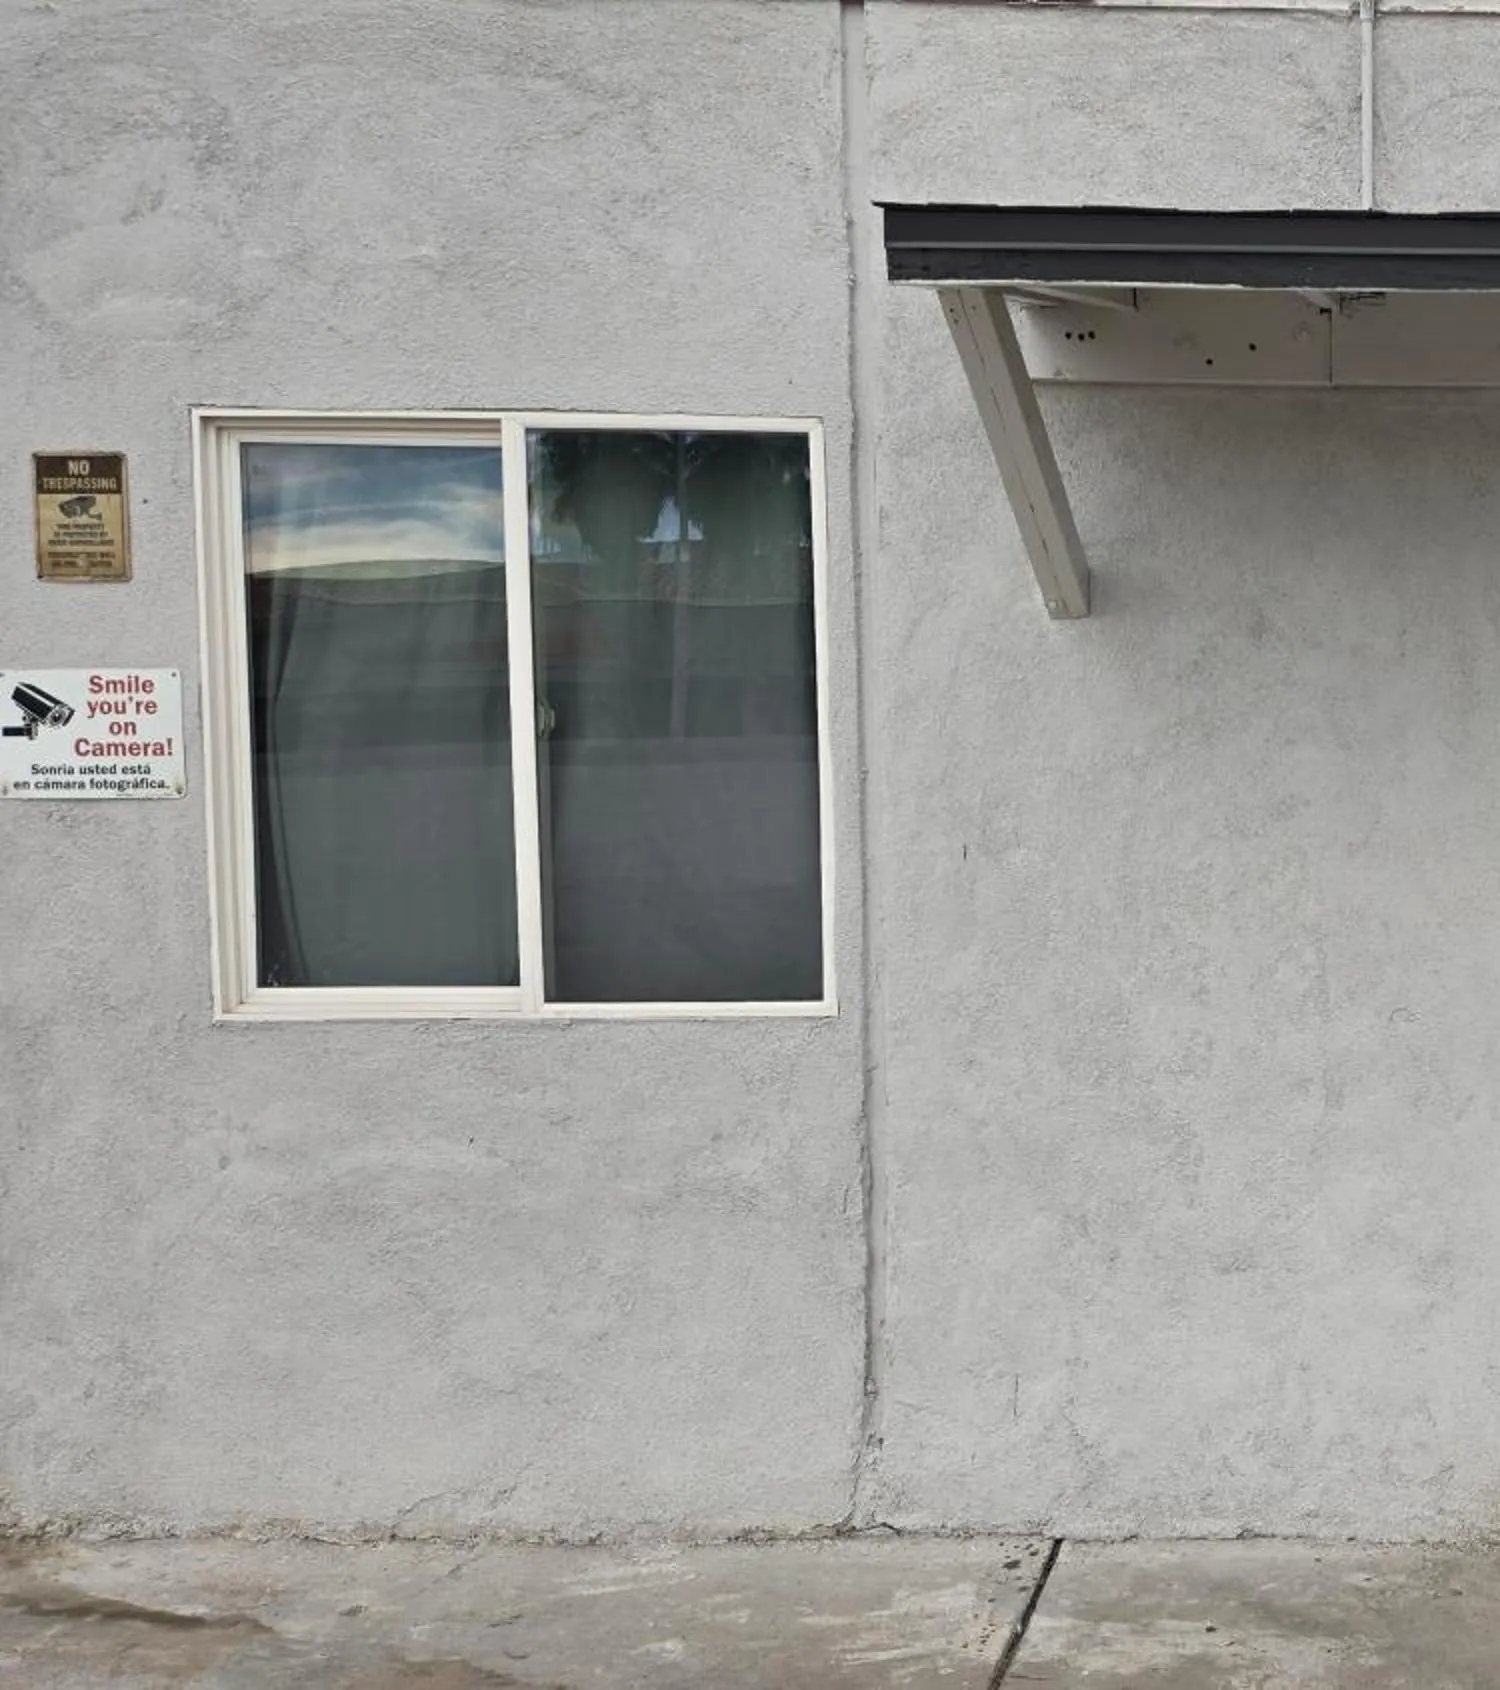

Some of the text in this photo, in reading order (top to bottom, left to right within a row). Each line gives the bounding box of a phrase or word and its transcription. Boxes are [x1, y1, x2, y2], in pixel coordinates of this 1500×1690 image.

[68, 460, 90, 476] NO
[43, 478, 117, 490] TRESPASSING
[88, 675, 155, 694] Smile
[87, 696, 158, 718] you're
[109, 721, 137, 735] on
[74, 738, 174, 756] Camera!
[79, 763, 117, 775] usted
[121, 763, 151, 775] está
[13, 778, 171, 792] en cámara fotográfica.
